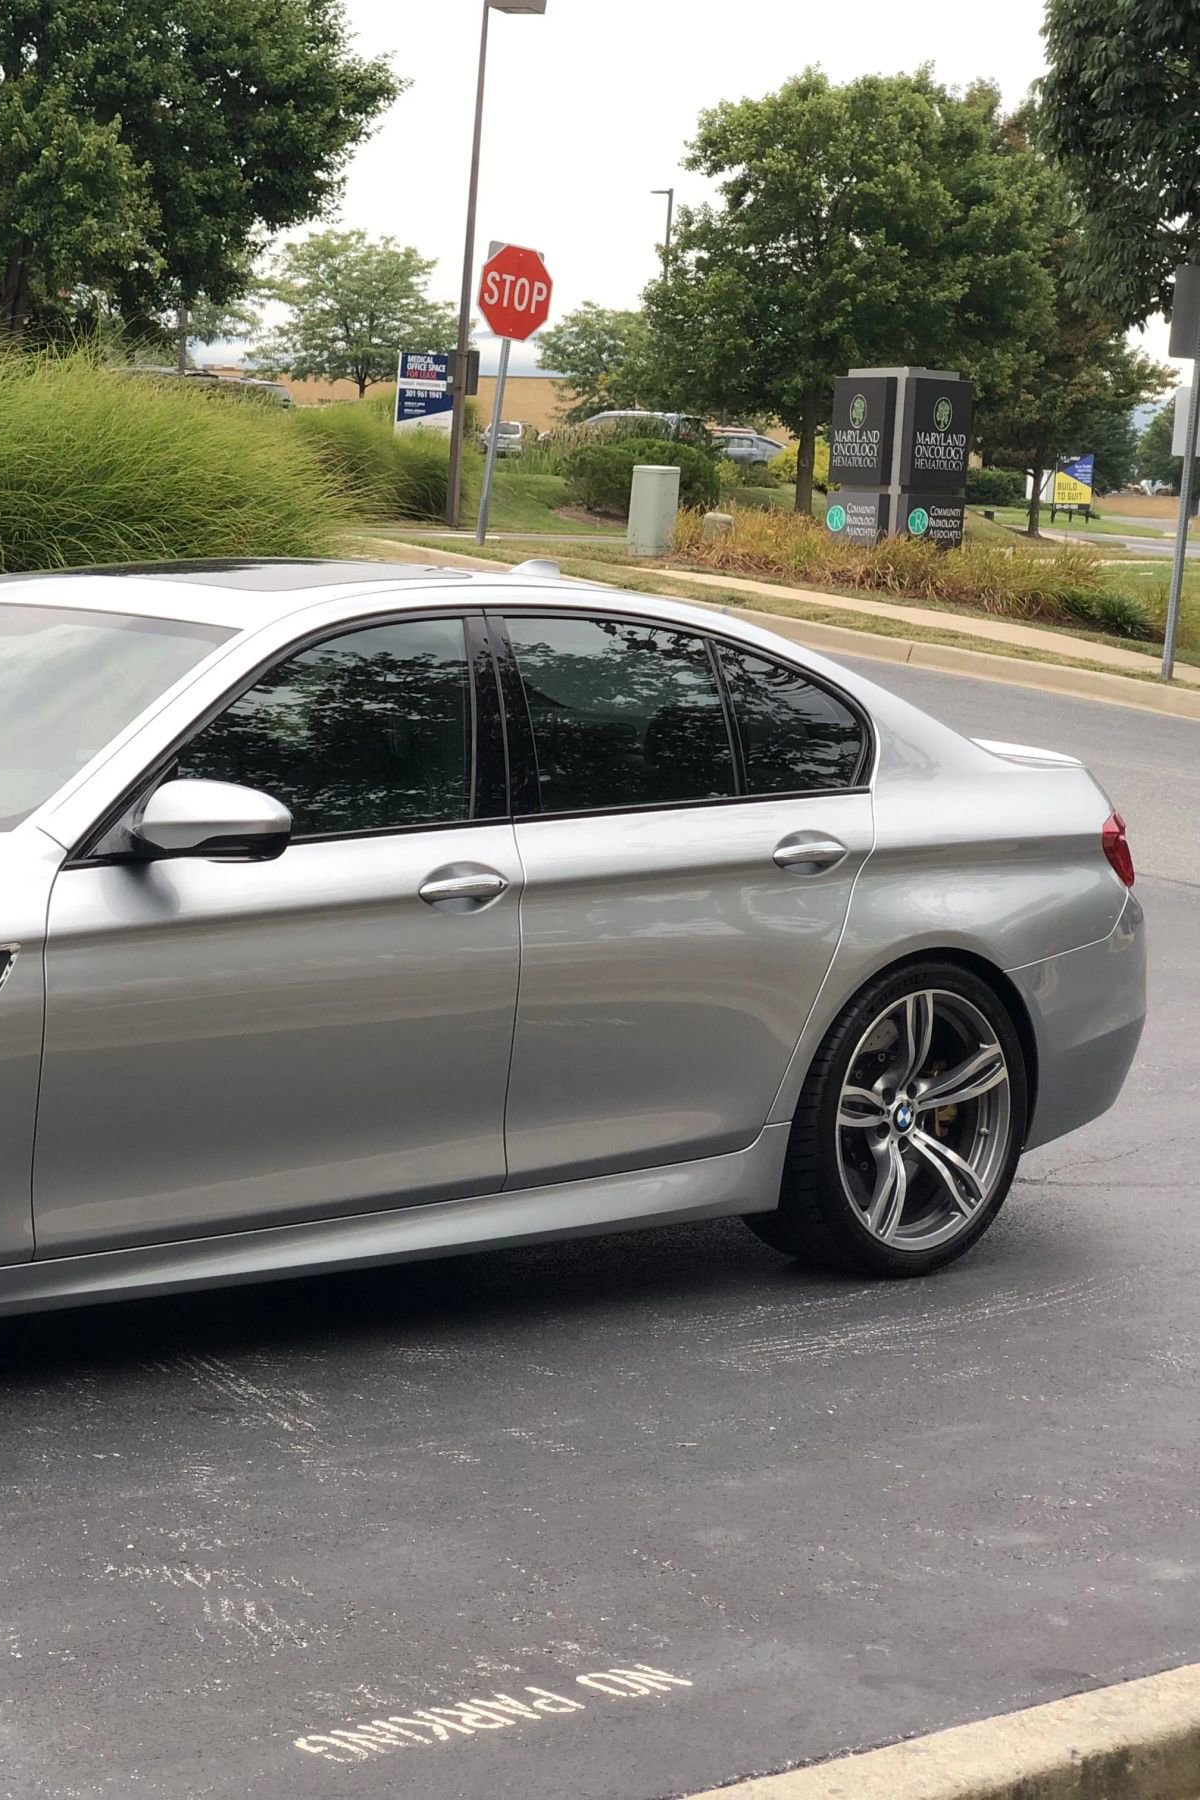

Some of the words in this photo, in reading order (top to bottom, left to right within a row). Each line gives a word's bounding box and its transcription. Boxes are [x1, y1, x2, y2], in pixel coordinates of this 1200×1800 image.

[483, 270, 548, 314] STOP
[408, 355, 434, 363] MEDICAL
[407, 363, 427, 371] OFFICE
[428, 364, 446, 372] SPACE
[420, 371, 438, 379] LEASE
[405, 390, 416, 399] 301
[417, 391, 428, 399] 961
[834, 430, 880, 443] MARYLAND
[916, 432, 966, 447] MARYLAND
[833, 443, 879, 456] ONCOLOGY
[914, 445, 965, 460] ONCOLOGY
[832, 456, 878, 468] HEMATOLOGY
[914, 458, 963, 471] HEMATOLOGY
[1057, 482, 1078, 490] BUILD
[1057, 492, 1066, 501] TO
[1067, 492, 1083, 501] SUIT
[846, 502, 876, 514] COMMUNITY
[929, 505, 962, 517] COMMUNITY
[846, 514, 876, 526] RADIOLOGY
[929, 517, 961, 529] RADIOLOGY
[928, 528, 962, 540] ASSOCIATES
[575, 1663, 694, 1698] NO
[294, 1686, 585, 1762] PARKING
